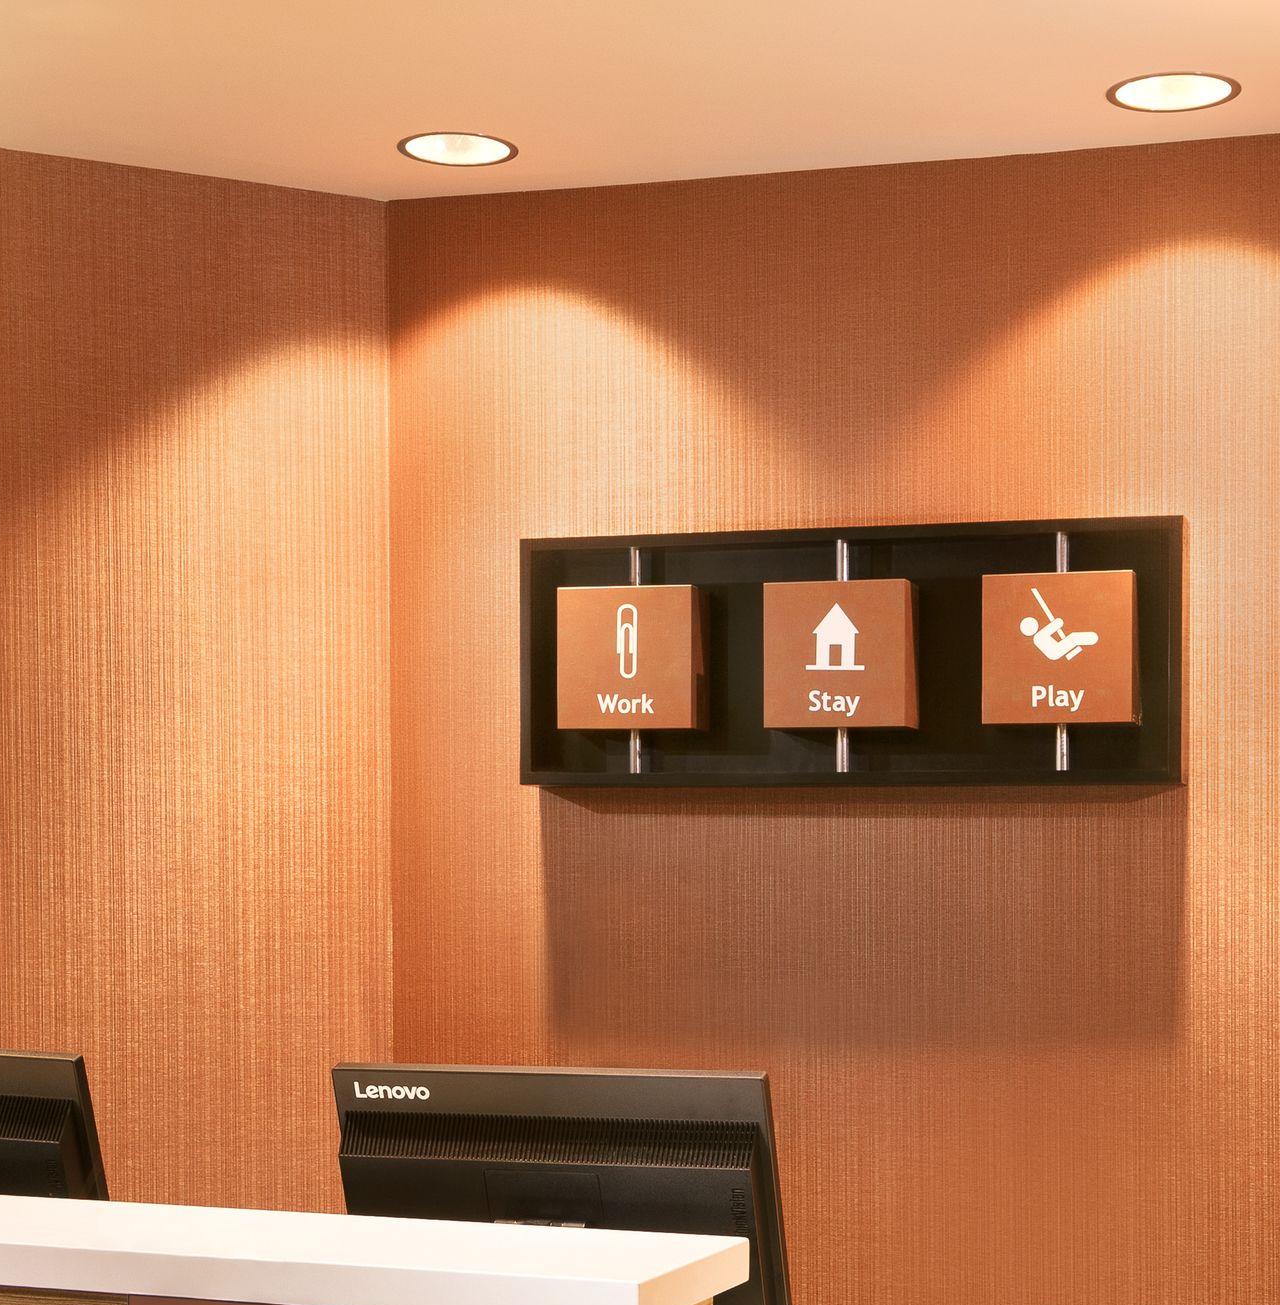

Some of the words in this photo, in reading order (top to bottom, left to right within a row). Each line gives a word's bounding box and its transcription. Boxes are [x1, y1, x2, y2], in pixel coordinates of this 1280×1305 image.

[596, 692, 655, 715] Work
[807, 688, 861, 718] Stay
[1031, 685, 1085, 714] Play
[353, 1081, 431, 1100] Lenovo
